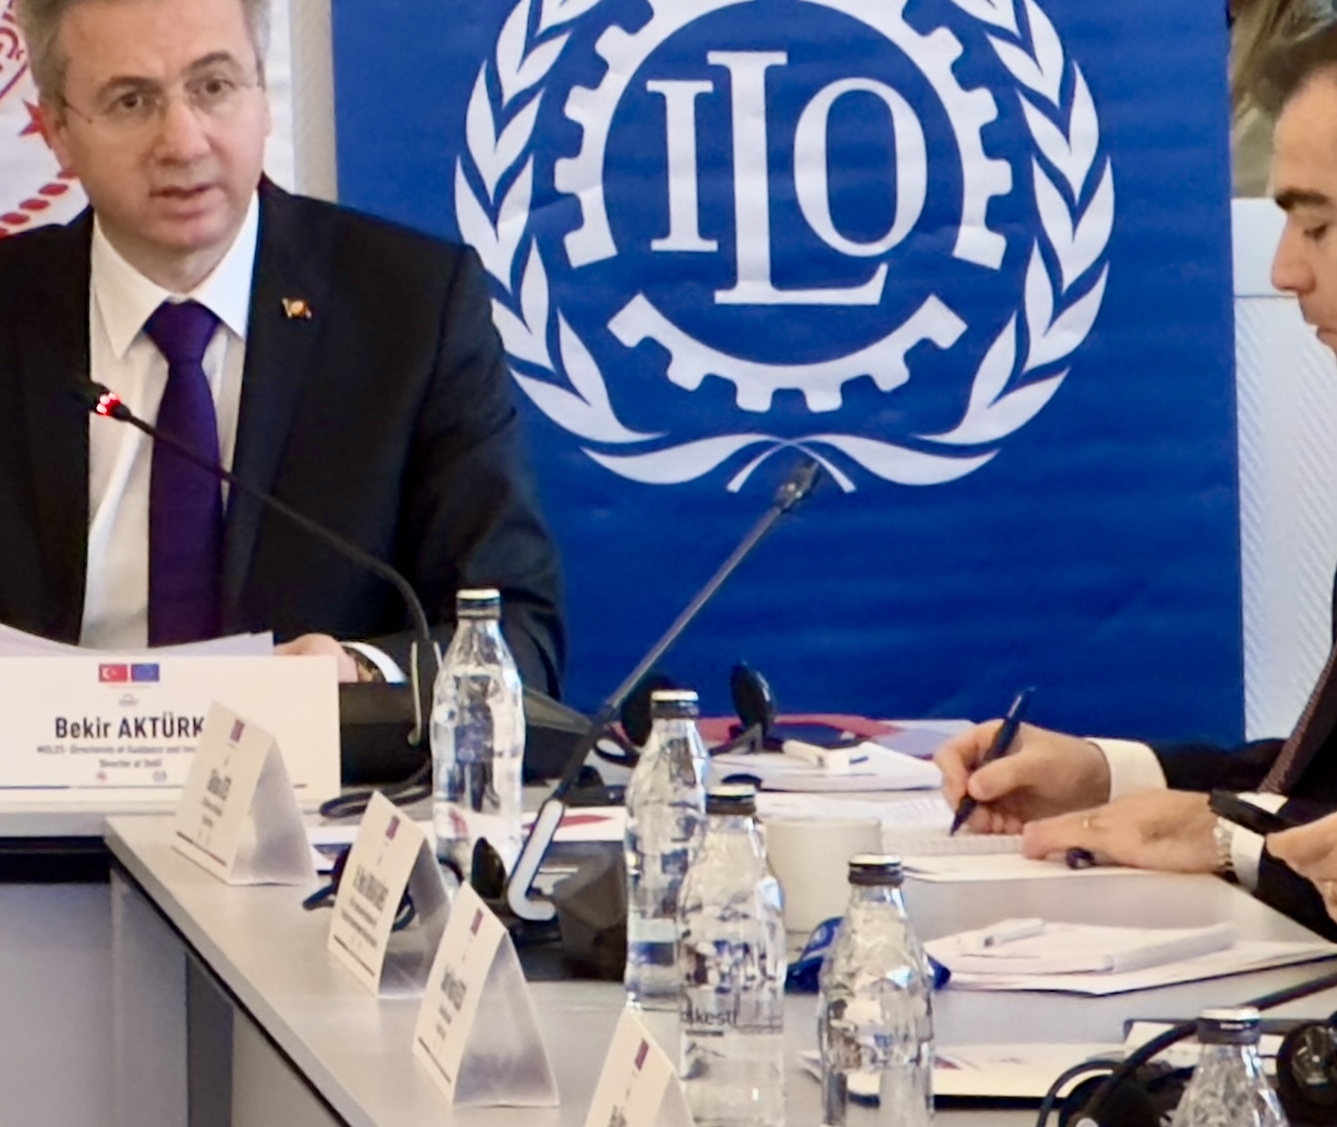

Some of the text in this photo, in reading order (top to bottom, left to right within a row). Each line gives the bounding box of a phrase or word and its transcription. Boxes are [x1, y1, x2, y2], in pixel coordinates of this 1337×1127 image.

[645, 50, 927, 306] ILO
[54, 710, 205, 739] Bekir AKTÜRK
